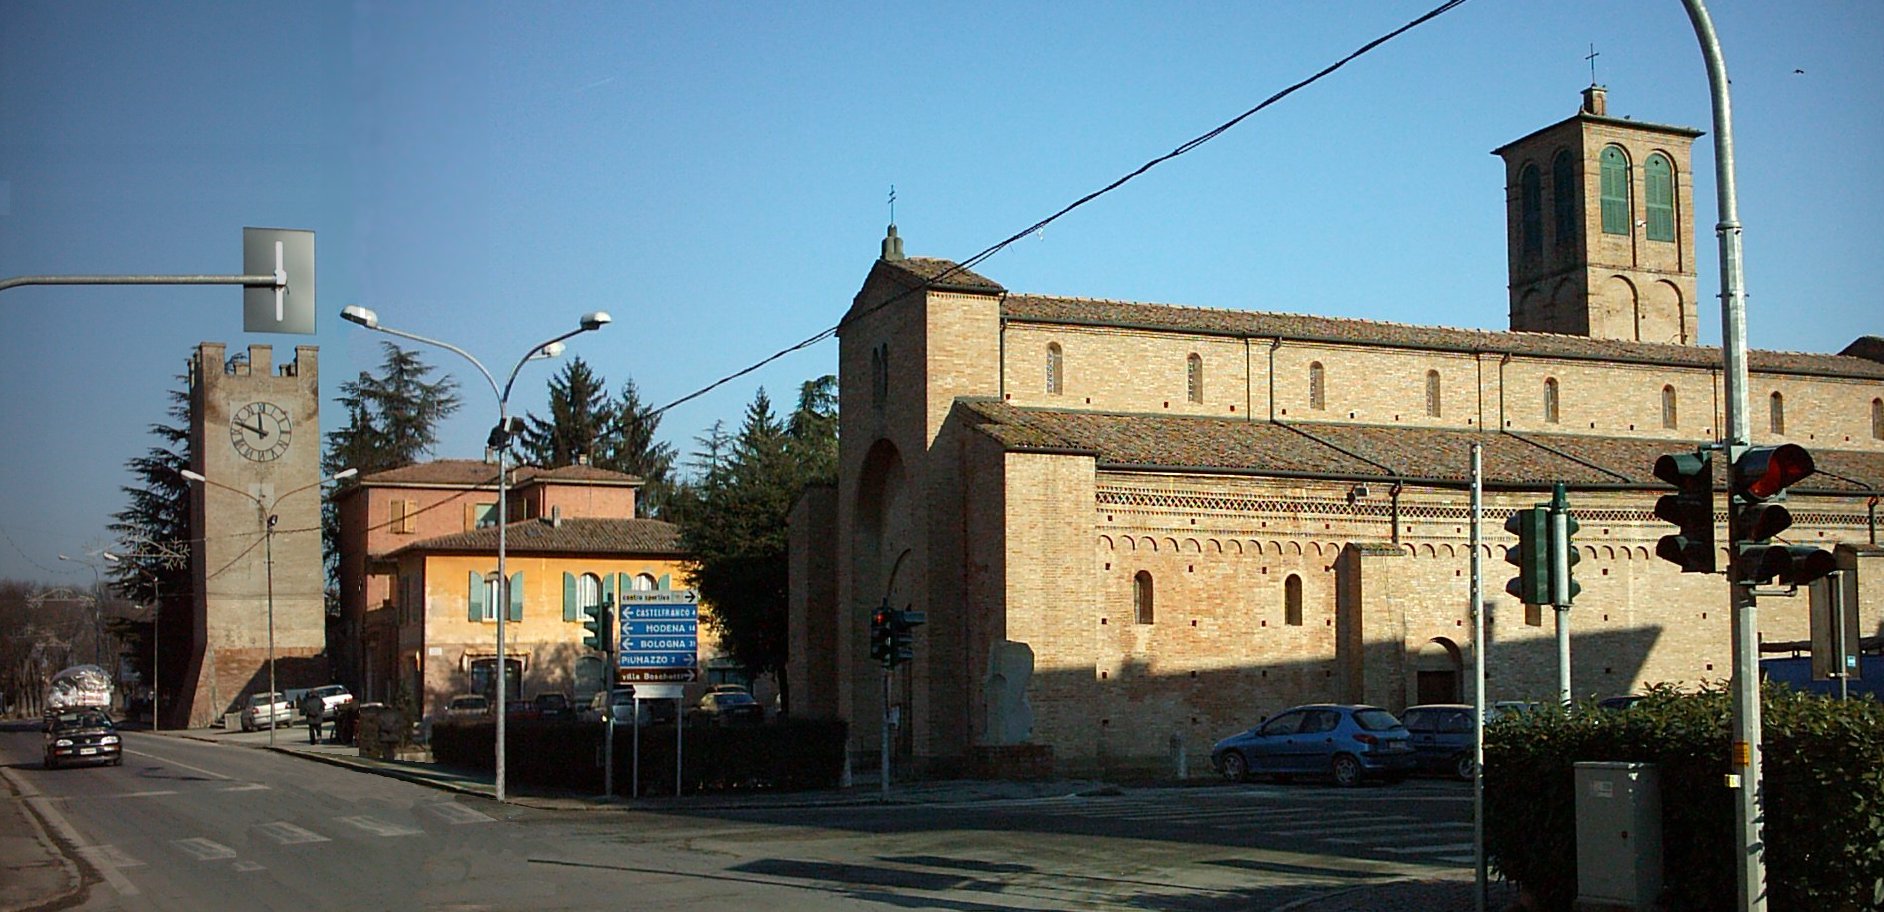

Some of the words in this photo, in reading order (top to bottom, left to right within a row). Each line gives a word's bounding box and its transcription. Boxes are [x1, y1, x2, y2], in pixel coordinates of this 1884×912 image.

[645, 594, 670, 602] sportivo
[636, 608, 690, 617] CASTELFRANCO
[645, 624, 685, 633] MODENA
[640, 640, 686, 648] BOLOGNA
